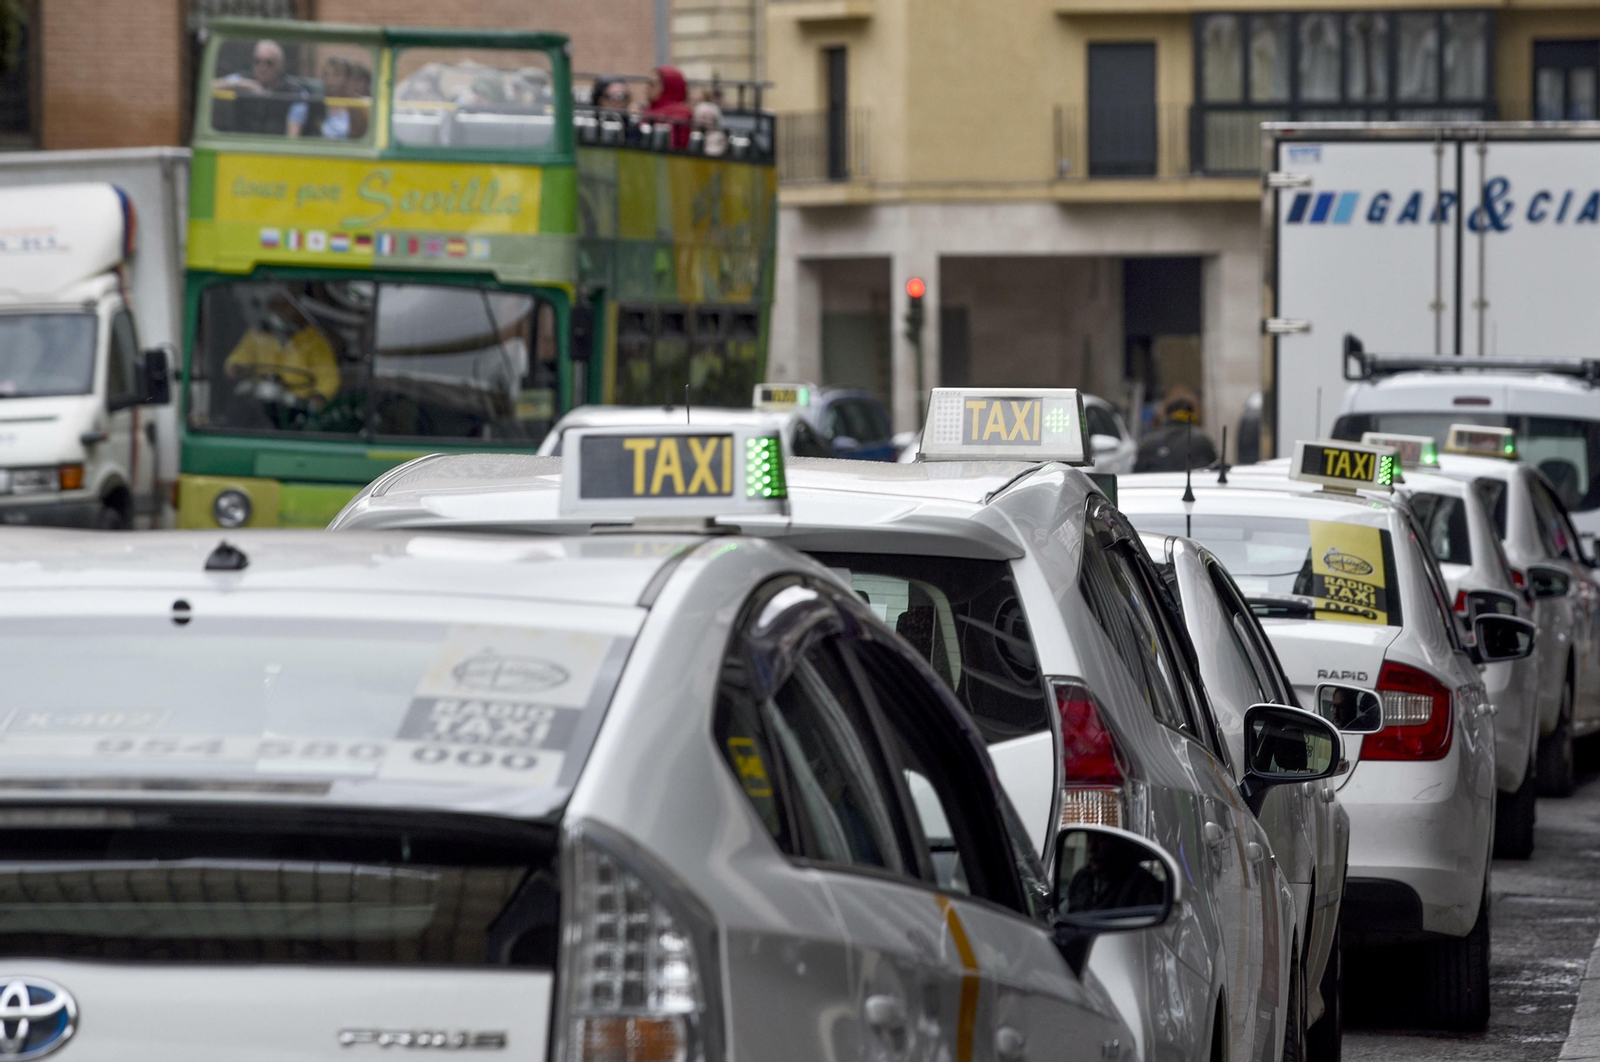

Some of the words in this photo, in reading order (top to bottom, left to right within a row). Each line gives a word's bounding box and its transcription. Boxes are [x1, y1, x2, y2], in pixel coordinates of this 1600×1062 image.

[340, 168, 521, 228] Sevilla
[1366, 190, 1457, 223] GAR
[1467, 176, 1514, 233] &
[1526, 190, 1600, 224] CIA
[966, 401, 1040, 441] TAXI
[623, 437, 733, 495] TAXI
[1323, 448, 1376, 480] TAXI
[1324, 576, 1375, 594] RADIO
[1325, 584, 1376, 608] TAXI
[1317, 669, 1368, 681] RAPID
[431, 700, 555, 719] RADIO
[432, 717, 553, 745] TAXI
[413, 747, 538, 771] 000
[338, 1031, 506, 1050] PRIUS
